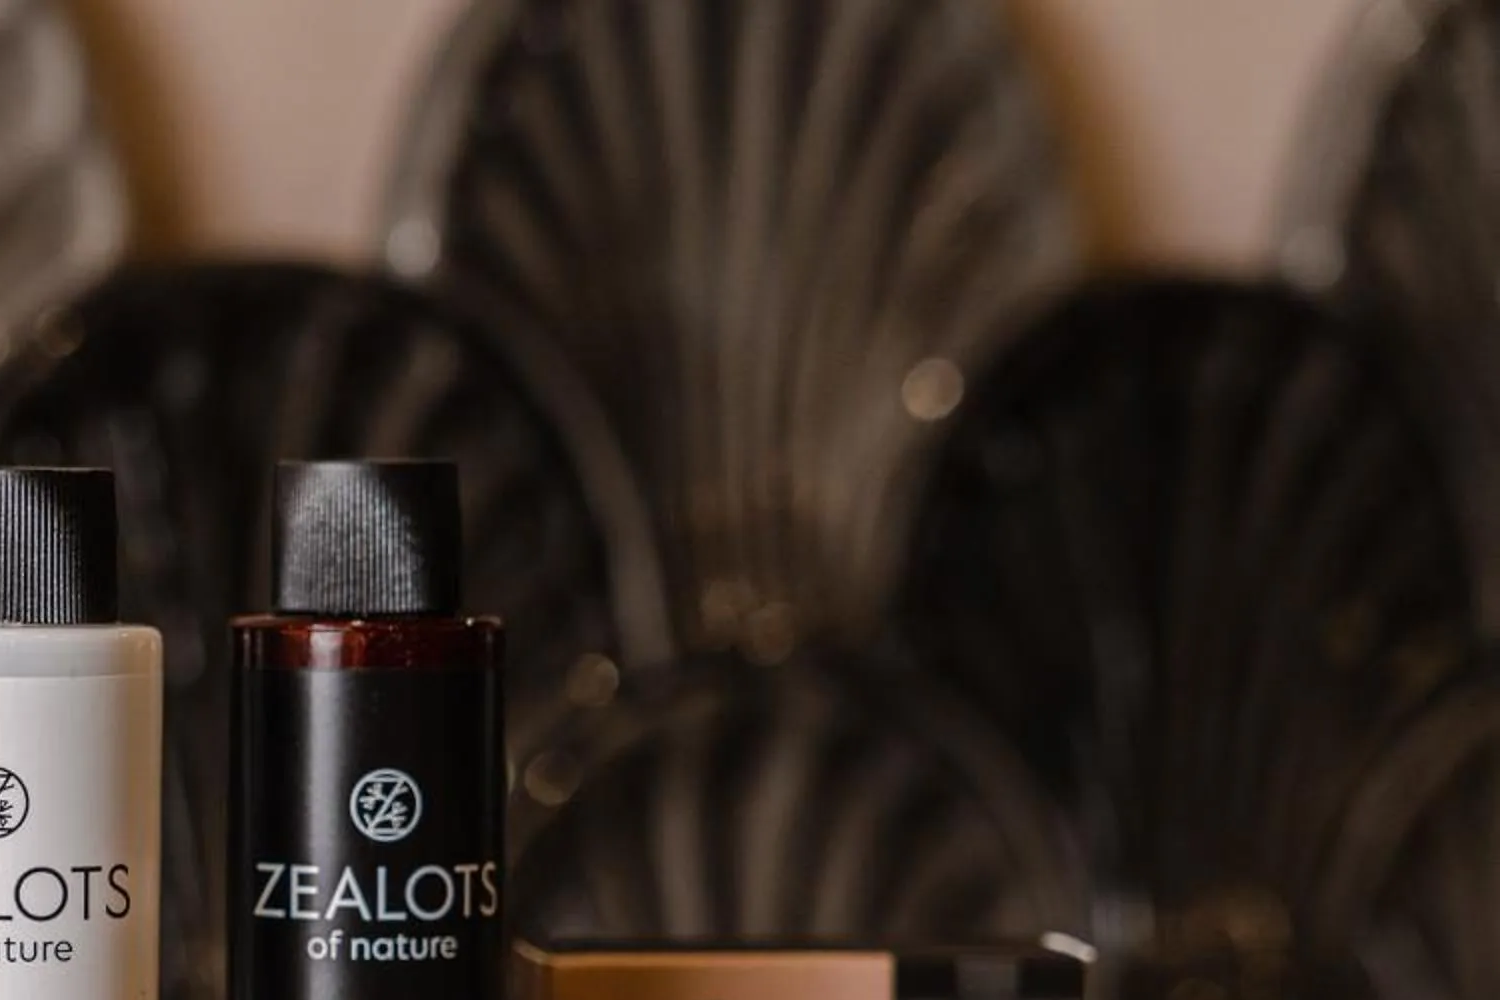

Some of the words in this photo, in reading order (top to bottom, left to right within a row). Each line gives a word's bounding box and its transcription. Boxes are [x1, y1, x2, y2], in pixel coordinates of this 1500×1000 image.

[254, 861, 497, 921] ZEALOTS
[307, 930, 343, 960] of
[351, 933, 458, 961] nature
